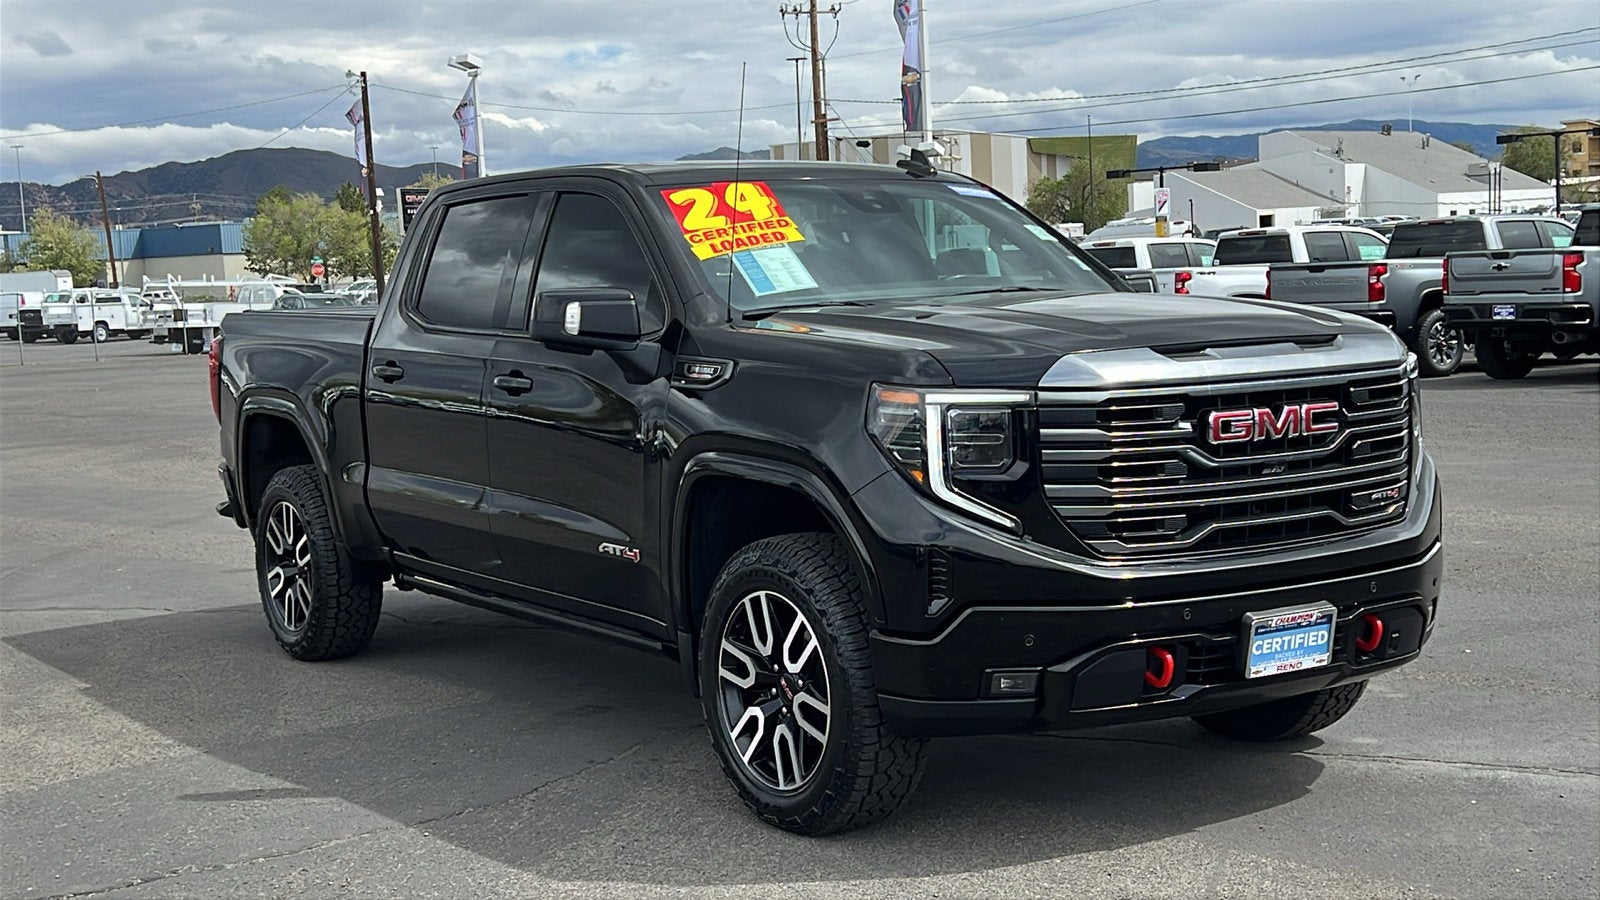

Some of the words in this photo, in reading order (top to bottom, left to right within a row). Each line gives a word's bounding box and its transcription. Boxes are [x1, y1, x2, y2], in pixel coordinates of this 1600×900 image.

[669, 181, 777, 231] 24
[688, 218, 792, 244] CERTIFIED
[707, 231, 788, 254] LOADED
[1208, 402, 1338, 443] GMC
[598, 542, 640, 563] AT4
[1275, 612, 1315, 625] CHAMPION
[1252, 630, 1329, 655] CERTIFIED
[1276, 661, 1303, 672] RENO
